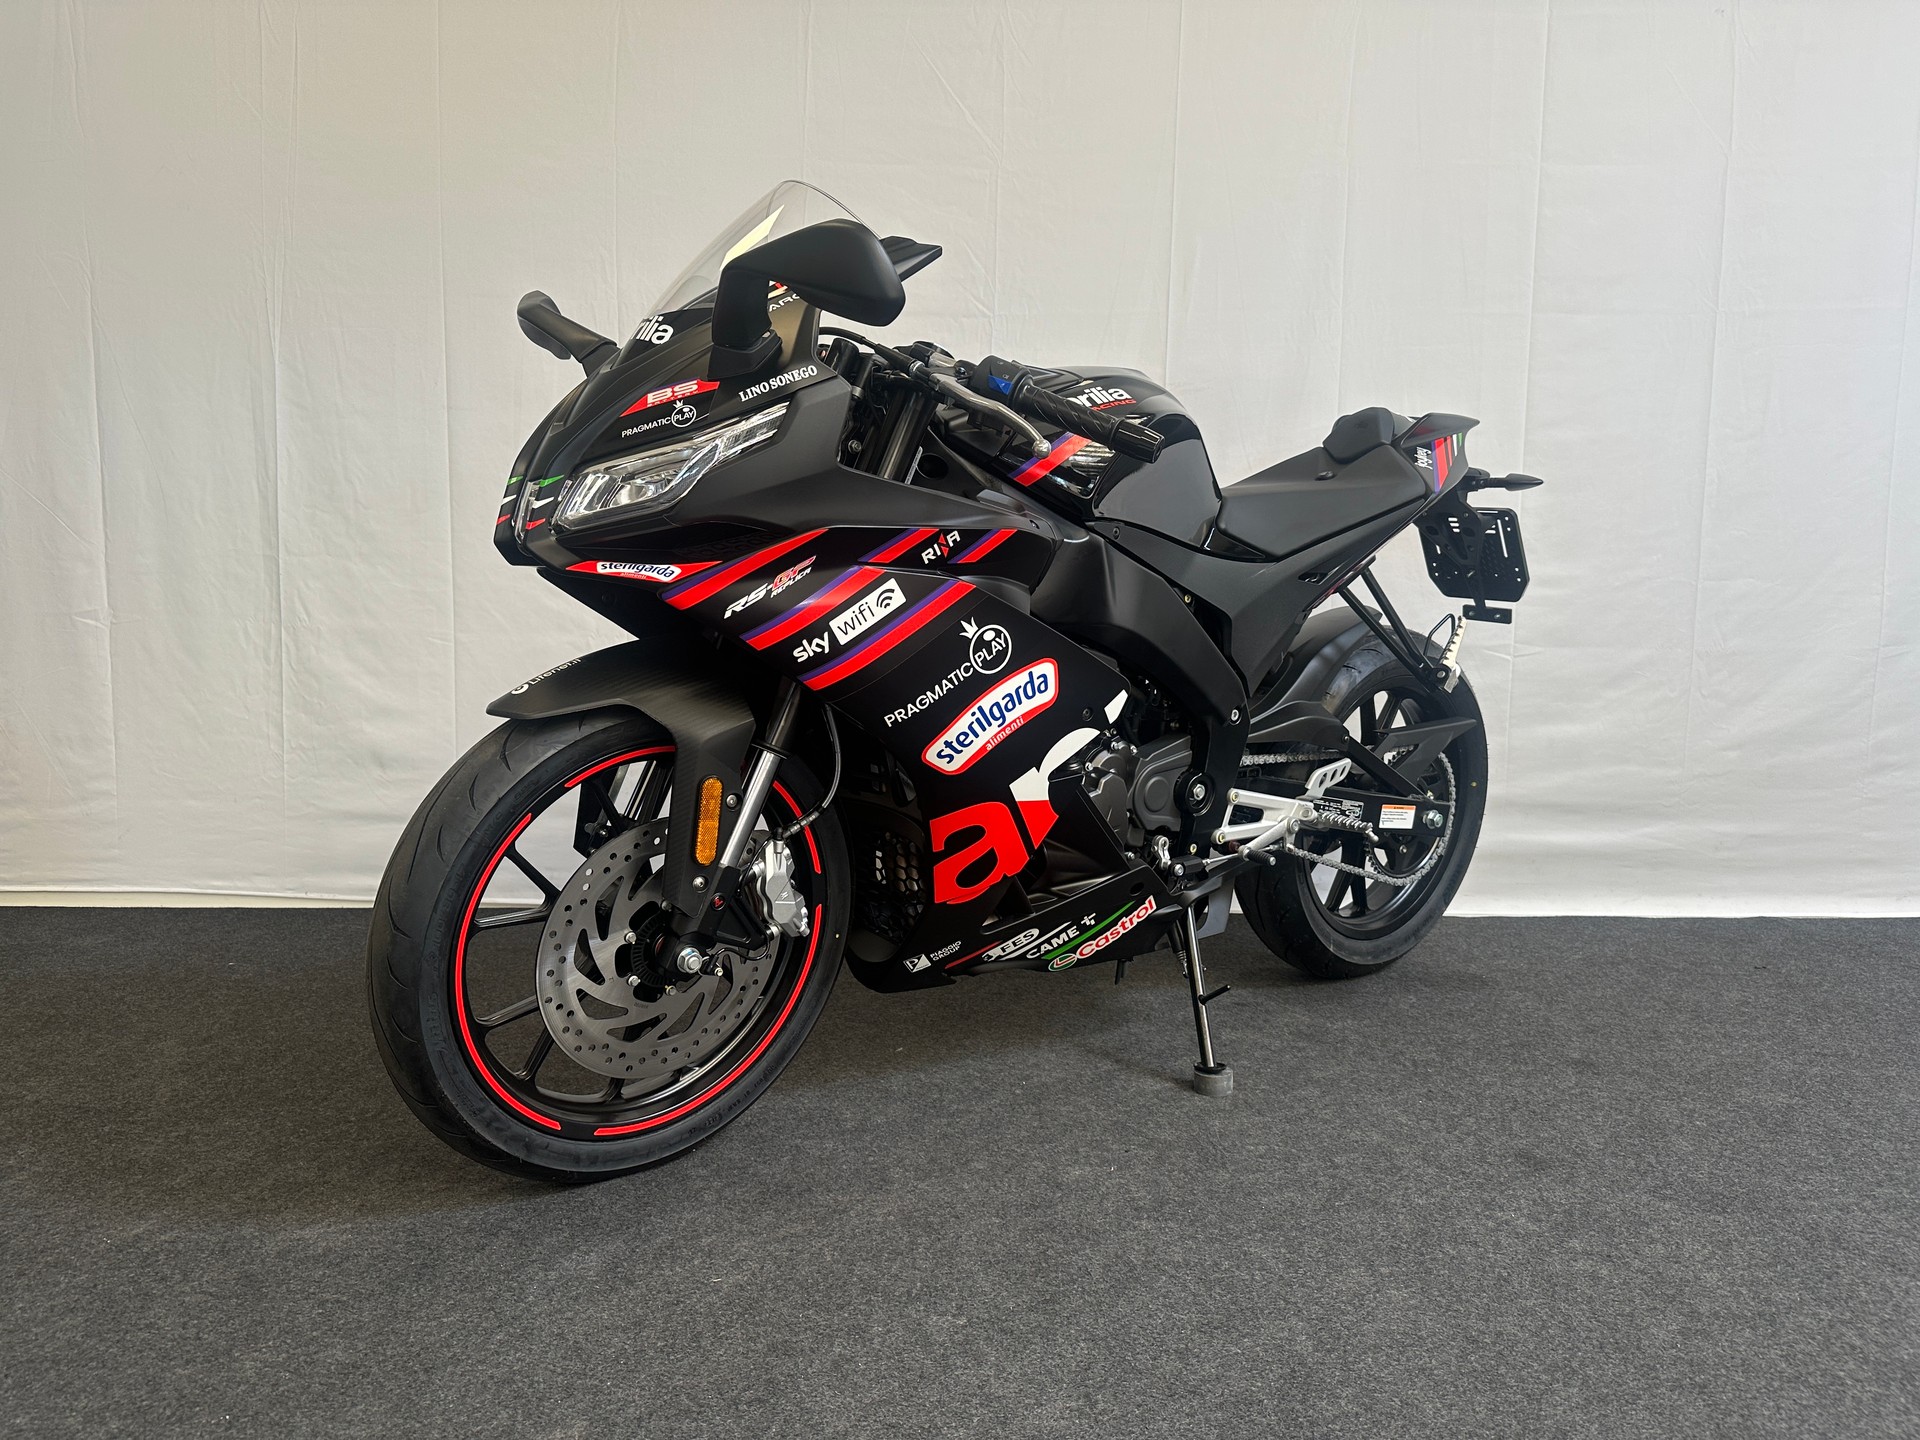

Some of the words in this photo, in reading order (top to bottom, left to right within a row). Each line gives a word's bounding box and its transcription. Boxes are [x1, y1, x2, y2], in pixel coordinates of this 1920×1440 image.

[647, 379, 699, 403] BS
[738, 384, 770, 402] LINO
[770, 365, 818, 391] SONEGO
[621, 416, 671, 438] PRAGMATIC
[673, 410, 695, 423] PLAY
[600, 561, 675, 579] sterilgarda
[770, 566, 812, 598] REPLICA
[792, 631, 830, 662] sky
[837, 600, 875, 637] wifi
[884, 662, 974, 728] PRAGMATIC
[974, 633, 1007, 667] PLAY
[936, 671, 1049, 764] sterilgarda
[985, 715, 1024, 751] alimenti
[1000, 930, 1036, 953] FES
[1026, 925, 1080, 959] CAME
[1076, 894, 1158, 959] Castrol
[930, 940, 962, 958] PIAGGIO
[932, 945, 961, 961] GROUP
